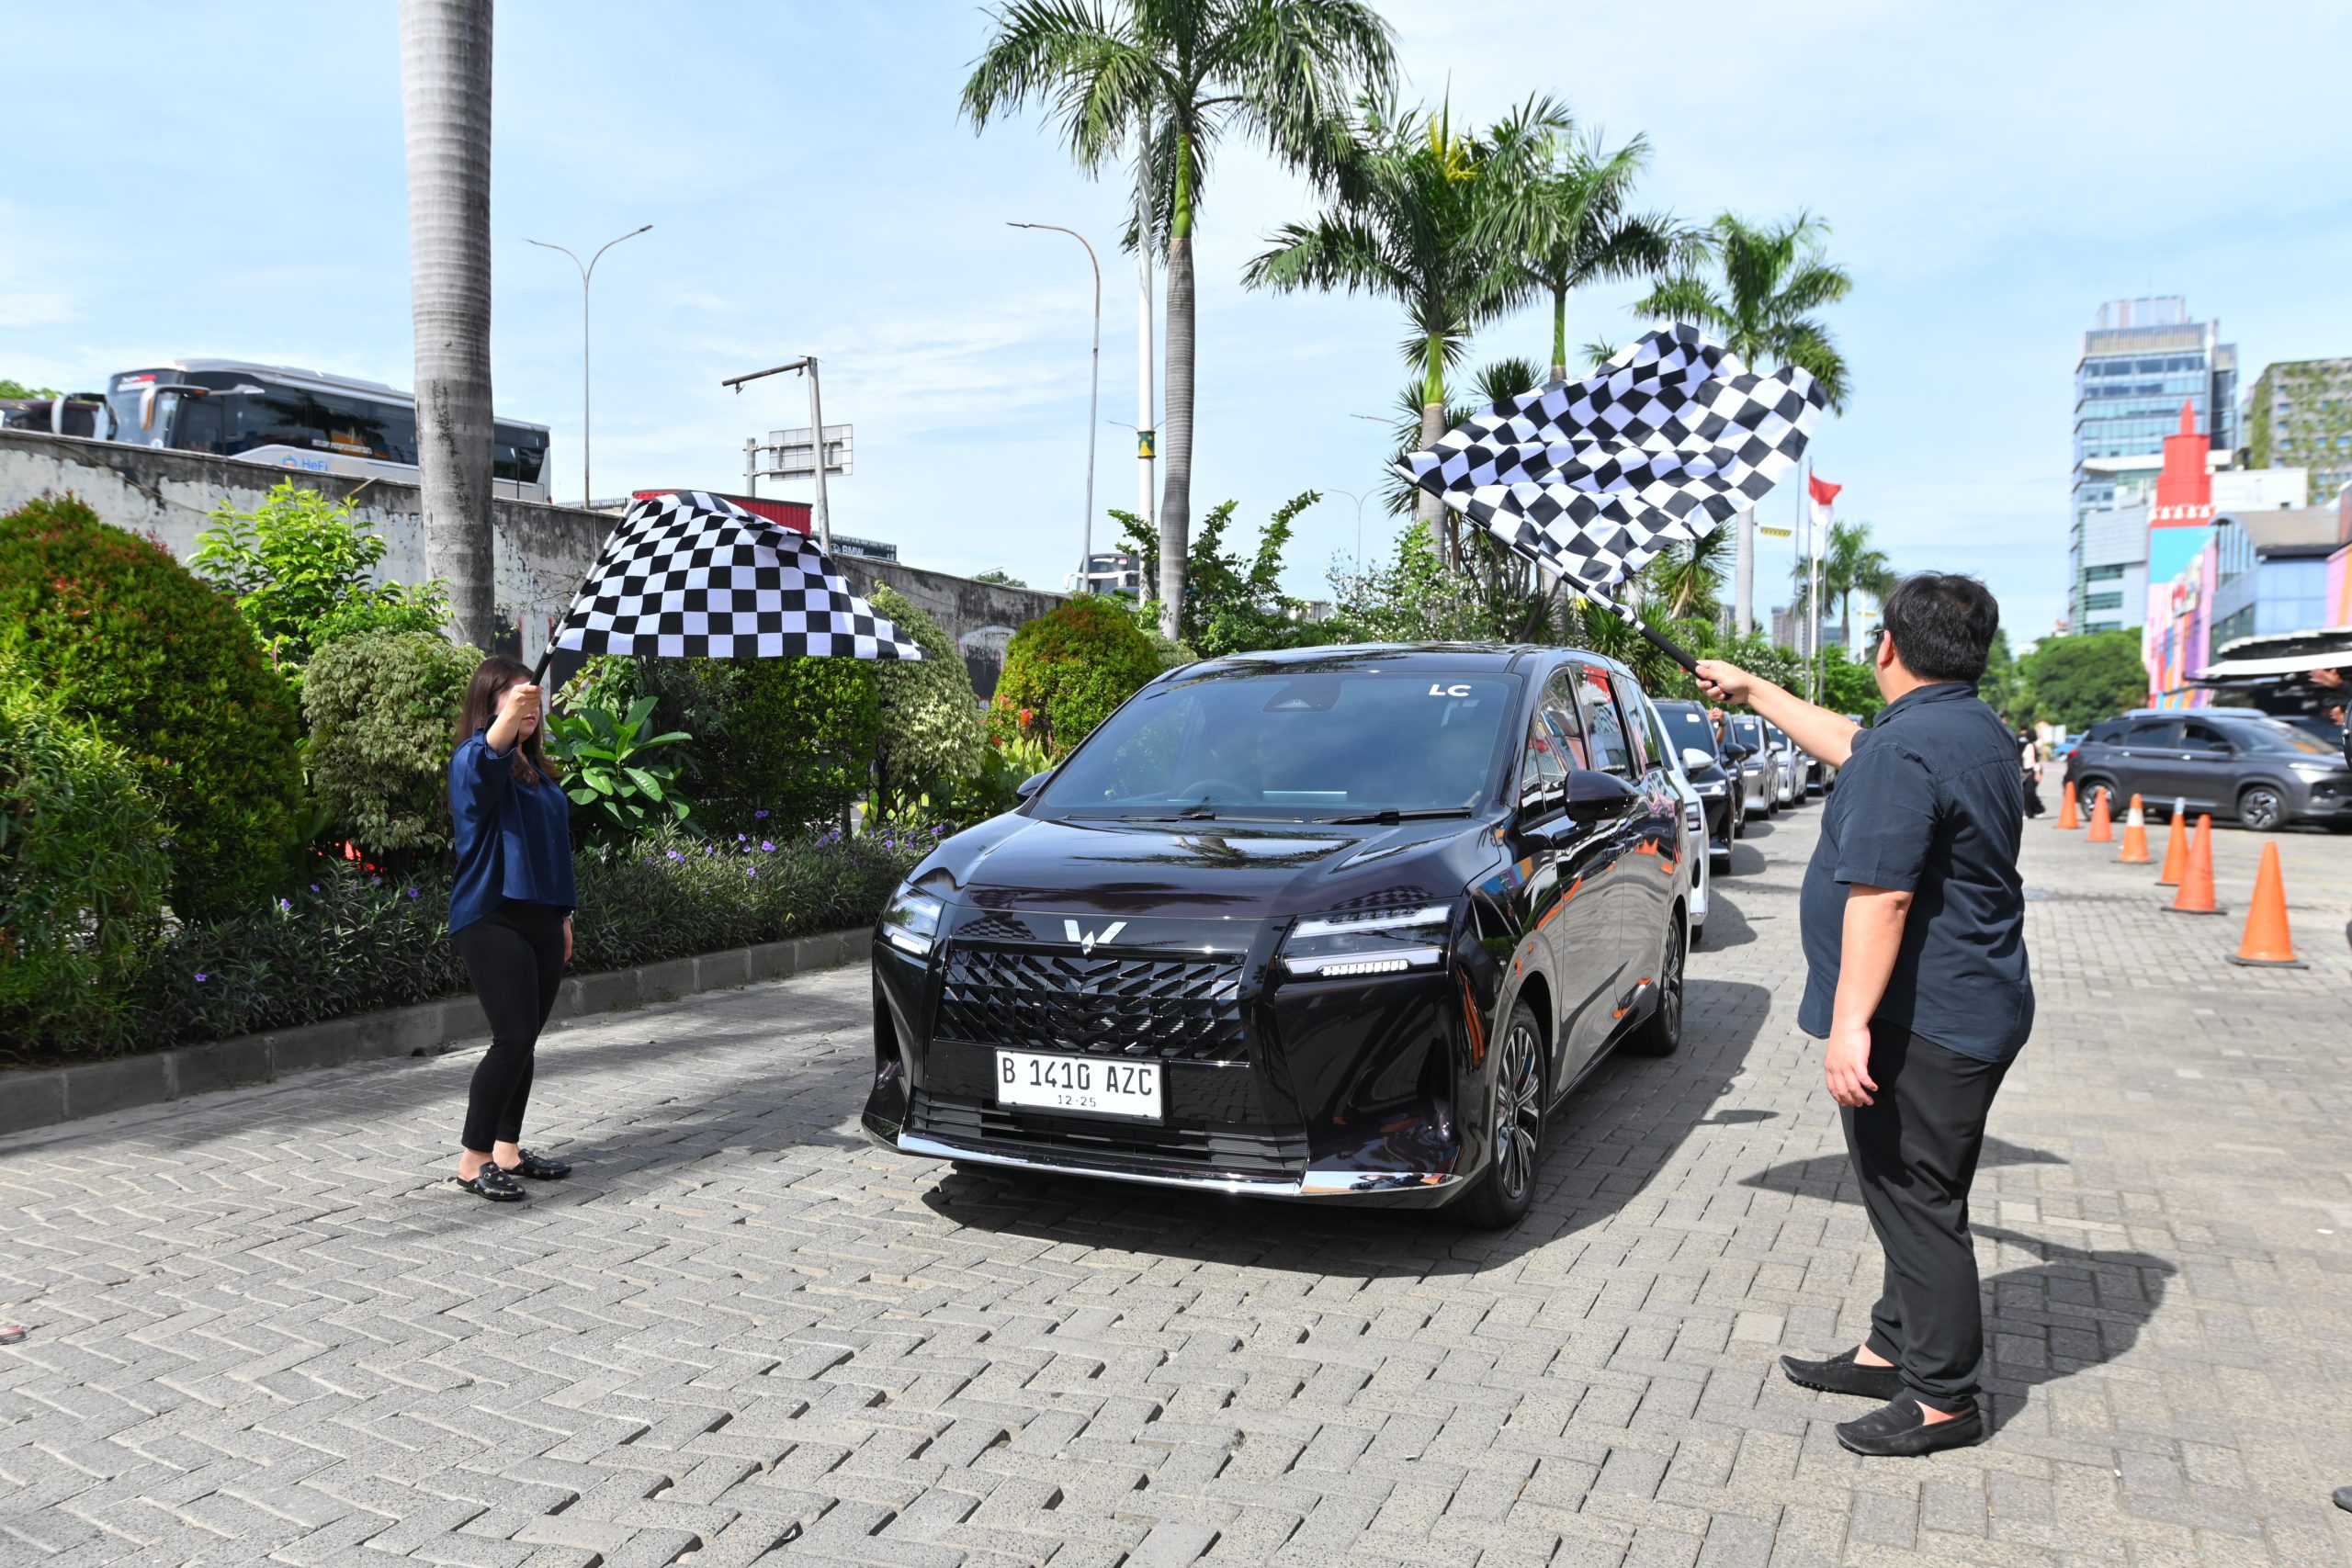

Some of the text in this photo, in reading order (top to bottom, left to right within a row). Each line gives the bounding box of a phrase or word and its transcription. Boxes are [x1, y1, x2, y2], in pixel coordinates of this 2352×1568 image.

[301, 457, 329, 471] HeFi
[842, 544, 864, 556] BMW
[1429, 683, 1472, 697] LC
[1002, 1056, 1152, 1096] B 1410 AZC
